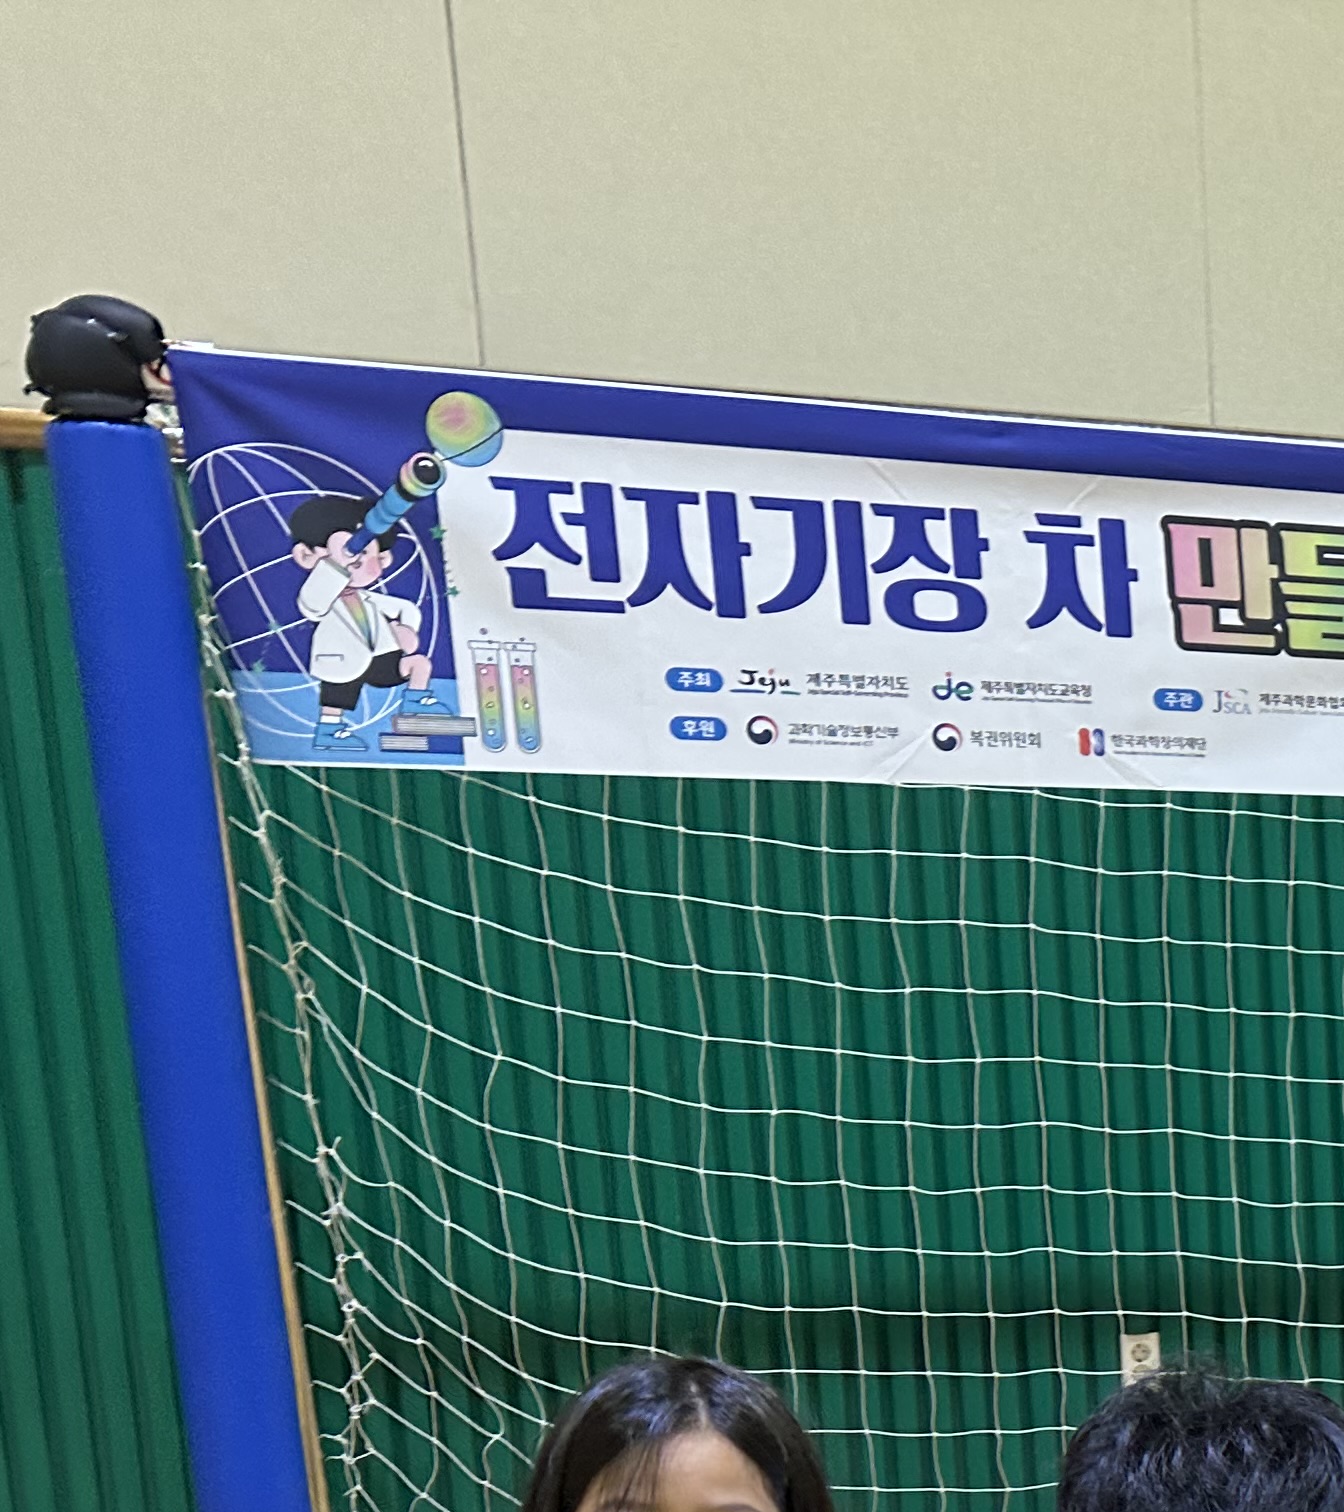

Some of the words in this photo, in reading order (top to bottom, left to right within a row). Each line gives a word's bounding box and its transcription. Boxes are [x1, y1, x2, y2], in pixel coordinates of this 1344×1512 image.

[488, 475, 990, 633] 전자기장
[1022, 510, 1140, 639] 차
[677, 670, 711, 688] 주최
[738, 668, 791, 695] Jeju
[806, 672, 910, 690] 제주특별자치도
[681, 720, 715, 738] 후원
[969, 729, 1042, 749] 복권위원회
